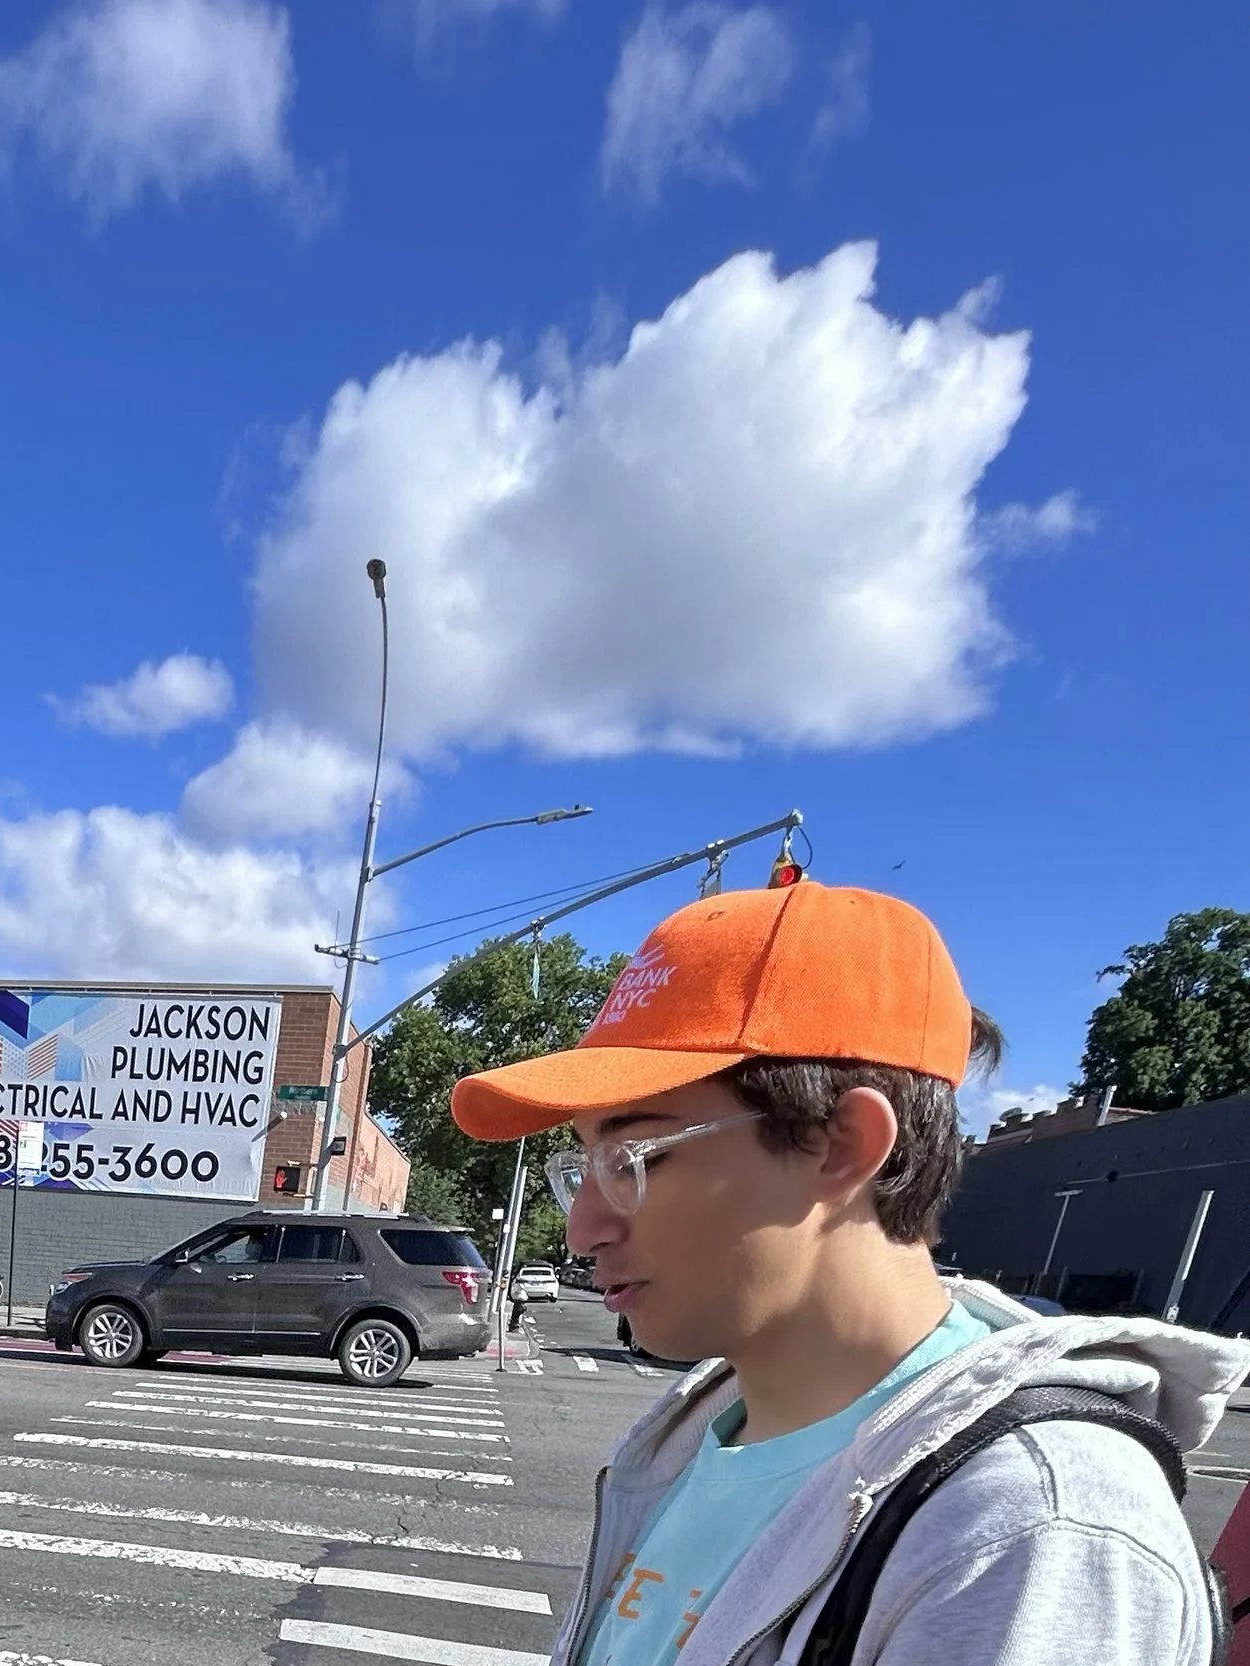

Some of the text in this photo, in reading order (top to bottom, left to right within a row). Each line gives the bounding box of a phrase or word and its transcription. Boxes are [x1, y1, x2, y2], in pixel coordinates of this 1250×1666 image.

[617, 966, 678, 991] BANK
[609, 988, 657, 1012] NYC
[129, 1003, 271, 1042] JACKSON
[111, 1045, 265, 1085] PLUMBING
[110, 1090, 173, 1124] AND
[181, 1091, 261, 1129] HVAC
